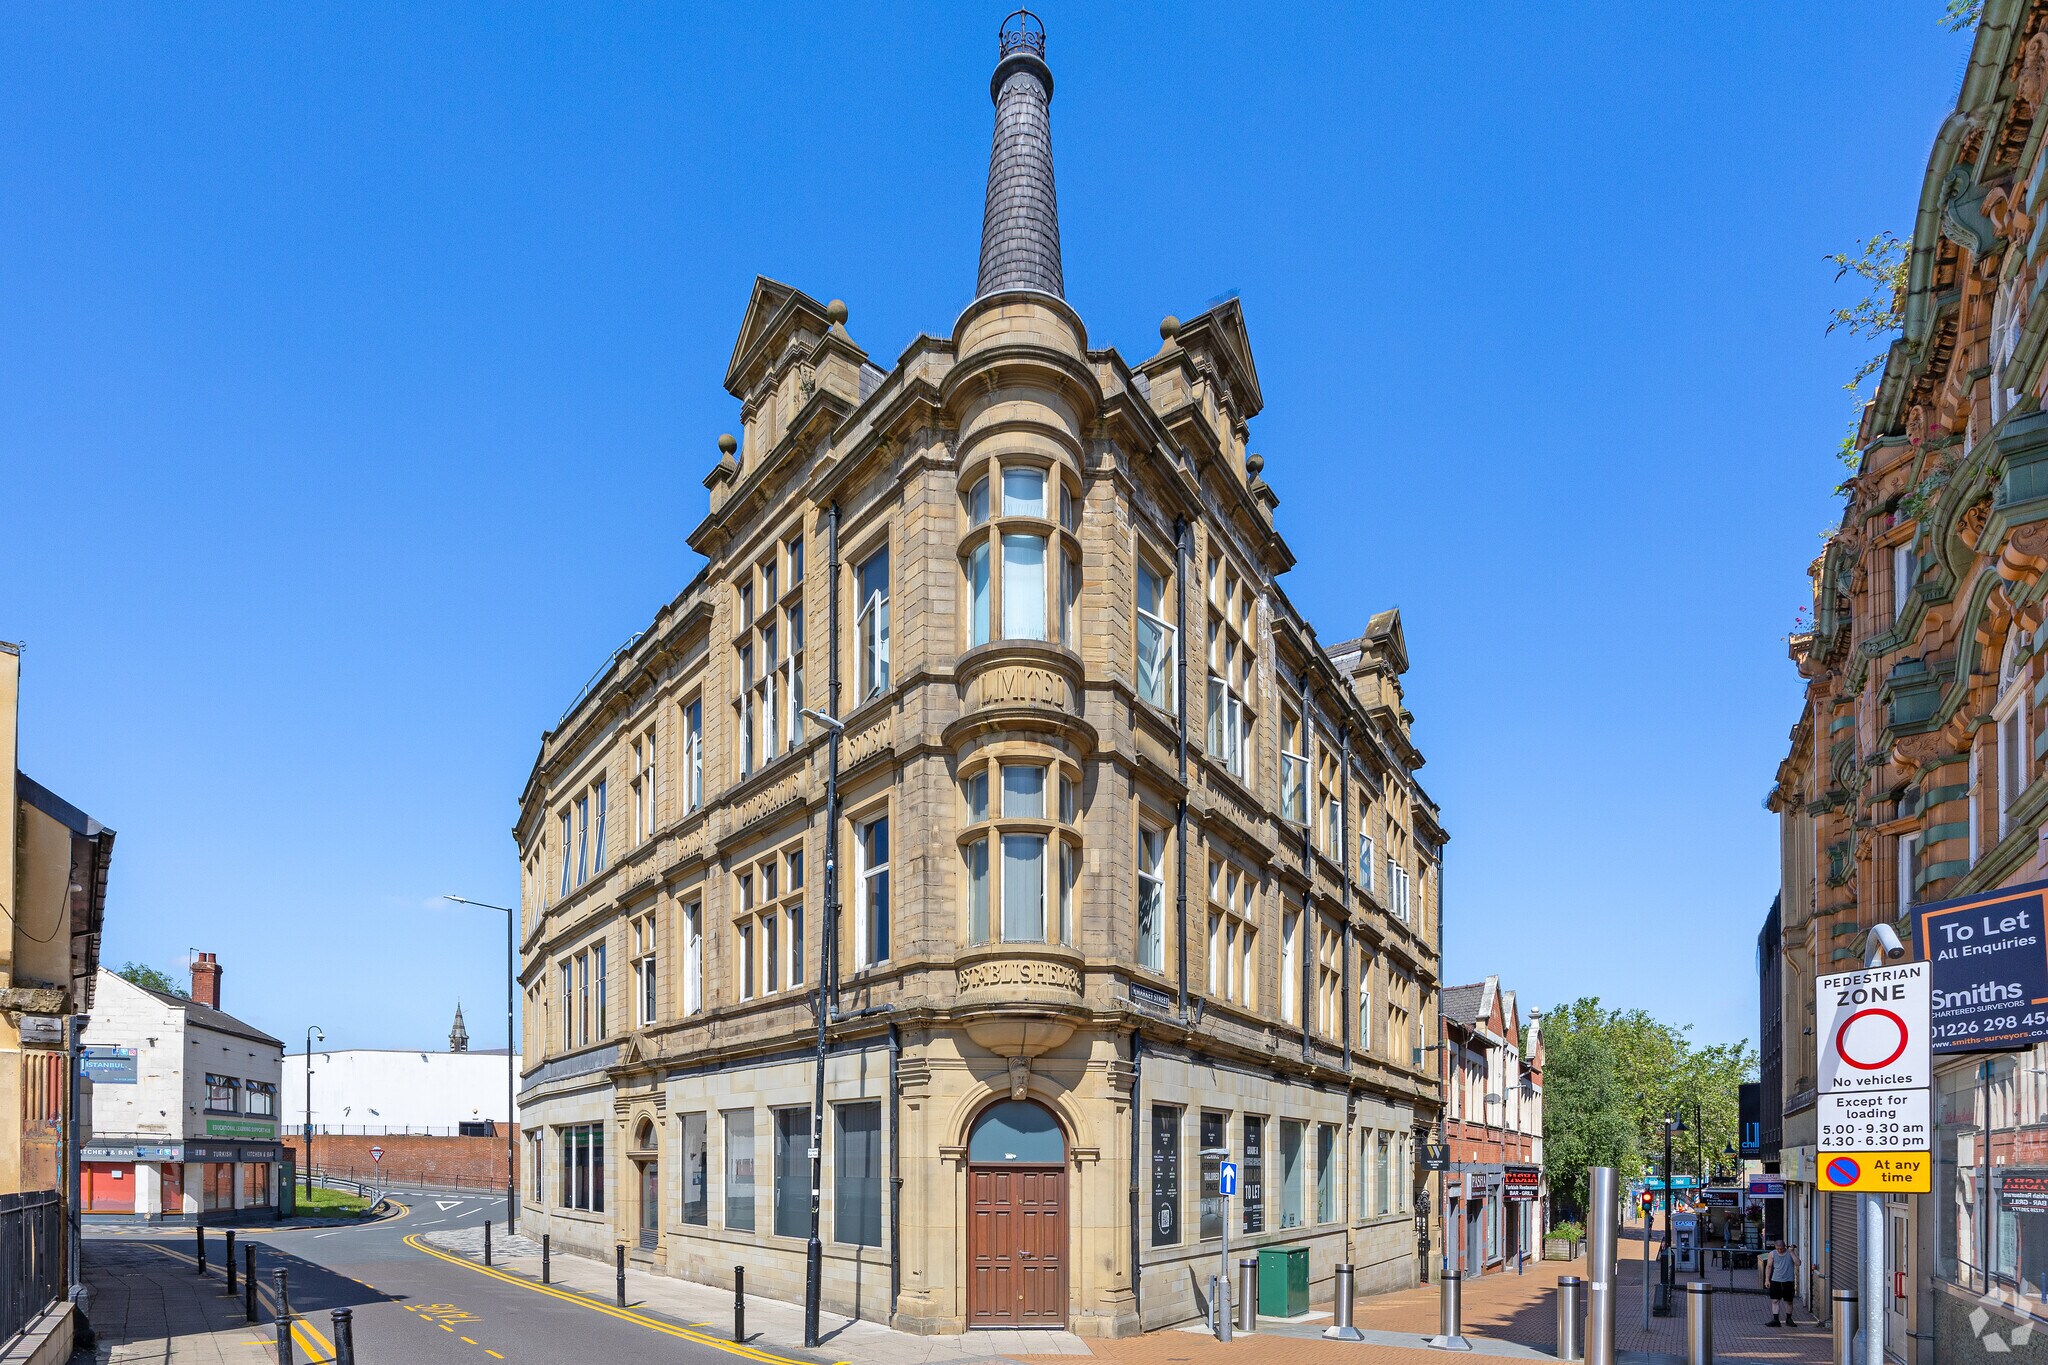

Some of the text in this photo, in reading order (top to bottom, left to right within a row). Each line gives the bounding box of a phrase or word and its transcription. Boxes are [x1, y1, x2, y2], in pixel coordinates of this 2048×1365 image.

[1940, 910, 2029, 943] To Let
[1937, 936, 2036, 961] All Enquiries
[1824, 967, 1920, 989] PEDESTRIAN
[1837, 984, 1905, 1007] ZONE
[1932, 981, 2023, 1010] Smiths
[1932, 1000, 2025, 1019] CHARTERED SURVEYORS
[1983, 1015, 2017, 1032] 298
[1833, 1074, 1912, 1087] No vehicles
[1836, 1095, 1908, 1107] Except for
[1846, 1108, 1896, 1119] loading
[1823, 1124, 1854, 1134] 5.00
[1866, 1123, 1899, 1133] 9.30
[1903, 1124, 1923, 1132] am
[1822, 1137, 1854, 1146] 4.30
[1866, 1136, 1898, 1146] 6.30
[1903, 1137, 1924, 1146] pm
[1874, 1160, 1920, 1171] At any
[1881, 1172, 1913, 1182] time
[1245, 1185, 1260, 1199] TO LET
